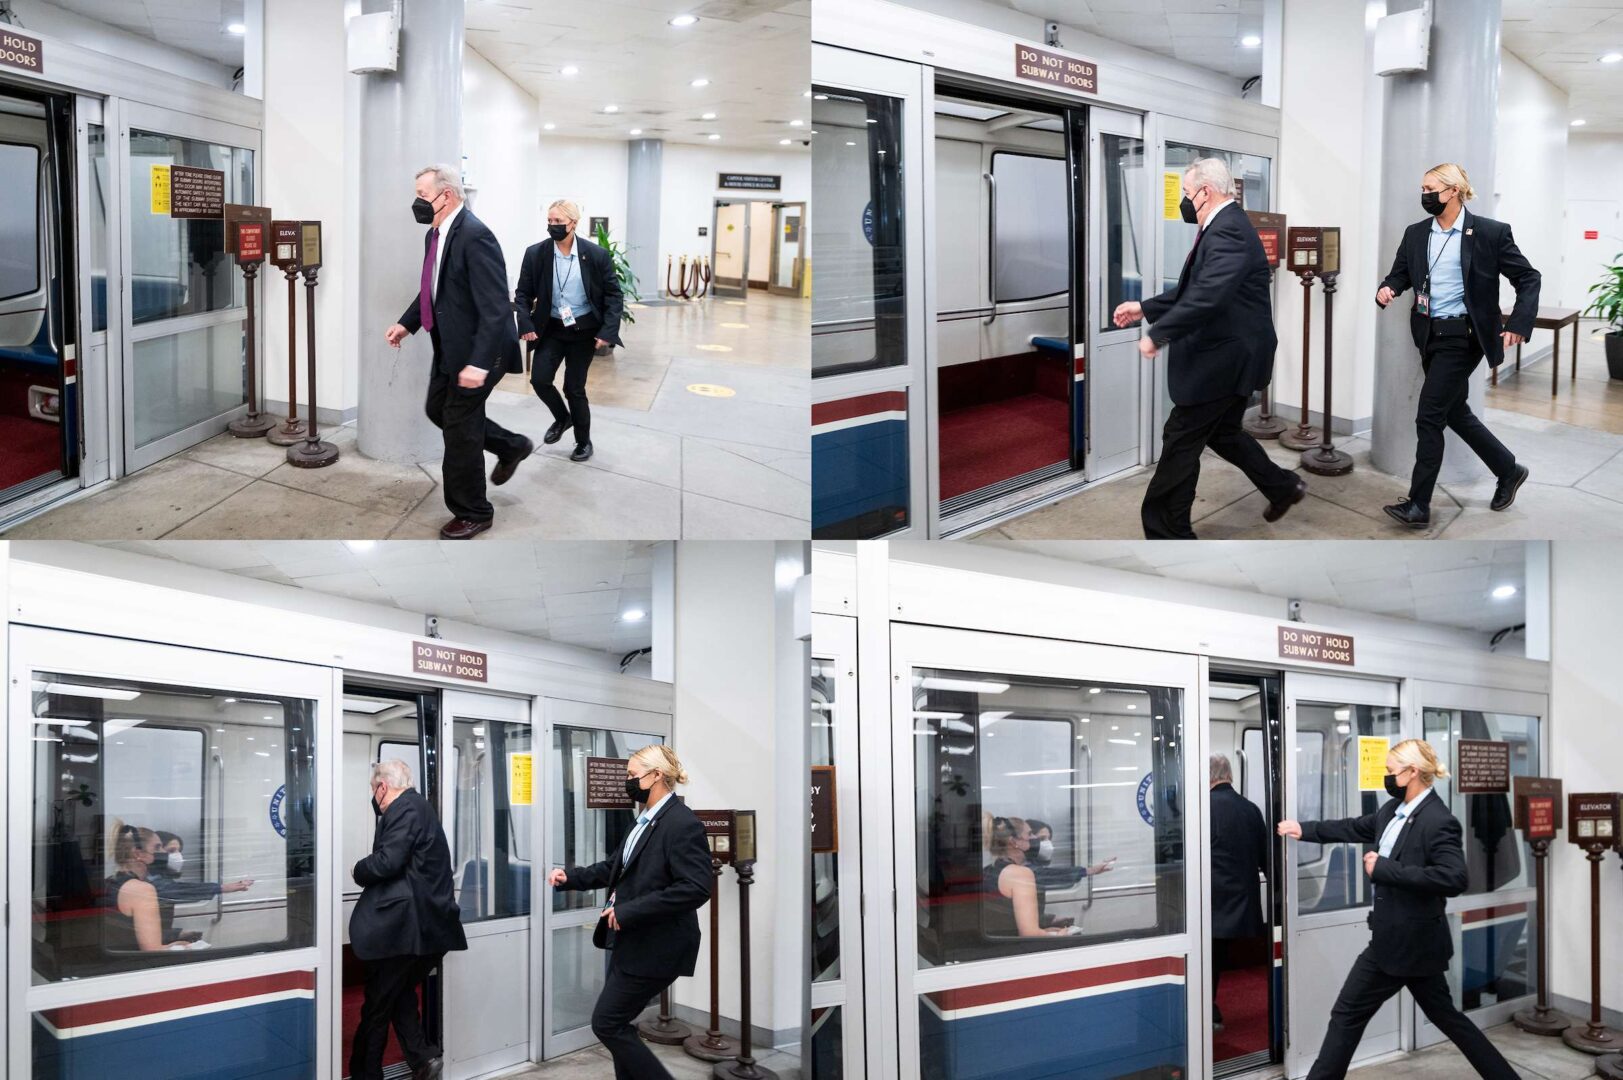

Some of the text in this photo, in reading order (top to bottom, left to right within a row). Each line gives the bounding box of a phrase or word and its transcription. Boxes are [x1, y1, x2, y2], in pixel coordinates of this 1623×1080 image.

[4, 36, 36, 52] HOLD
[1021, 50, 1093, 76] DO NOT HOLD
[1022, 64, 1093, 89] SUBWAY DOORS
[1283, 631, 1349, 649] DO NOT HOLD
[418, 646, 483, 666] DO NOT HOLD
[1284, 644, 1350, 661] SUBWAY DOORS
[418, 660, 483, 678] SUBWAY DOORS
